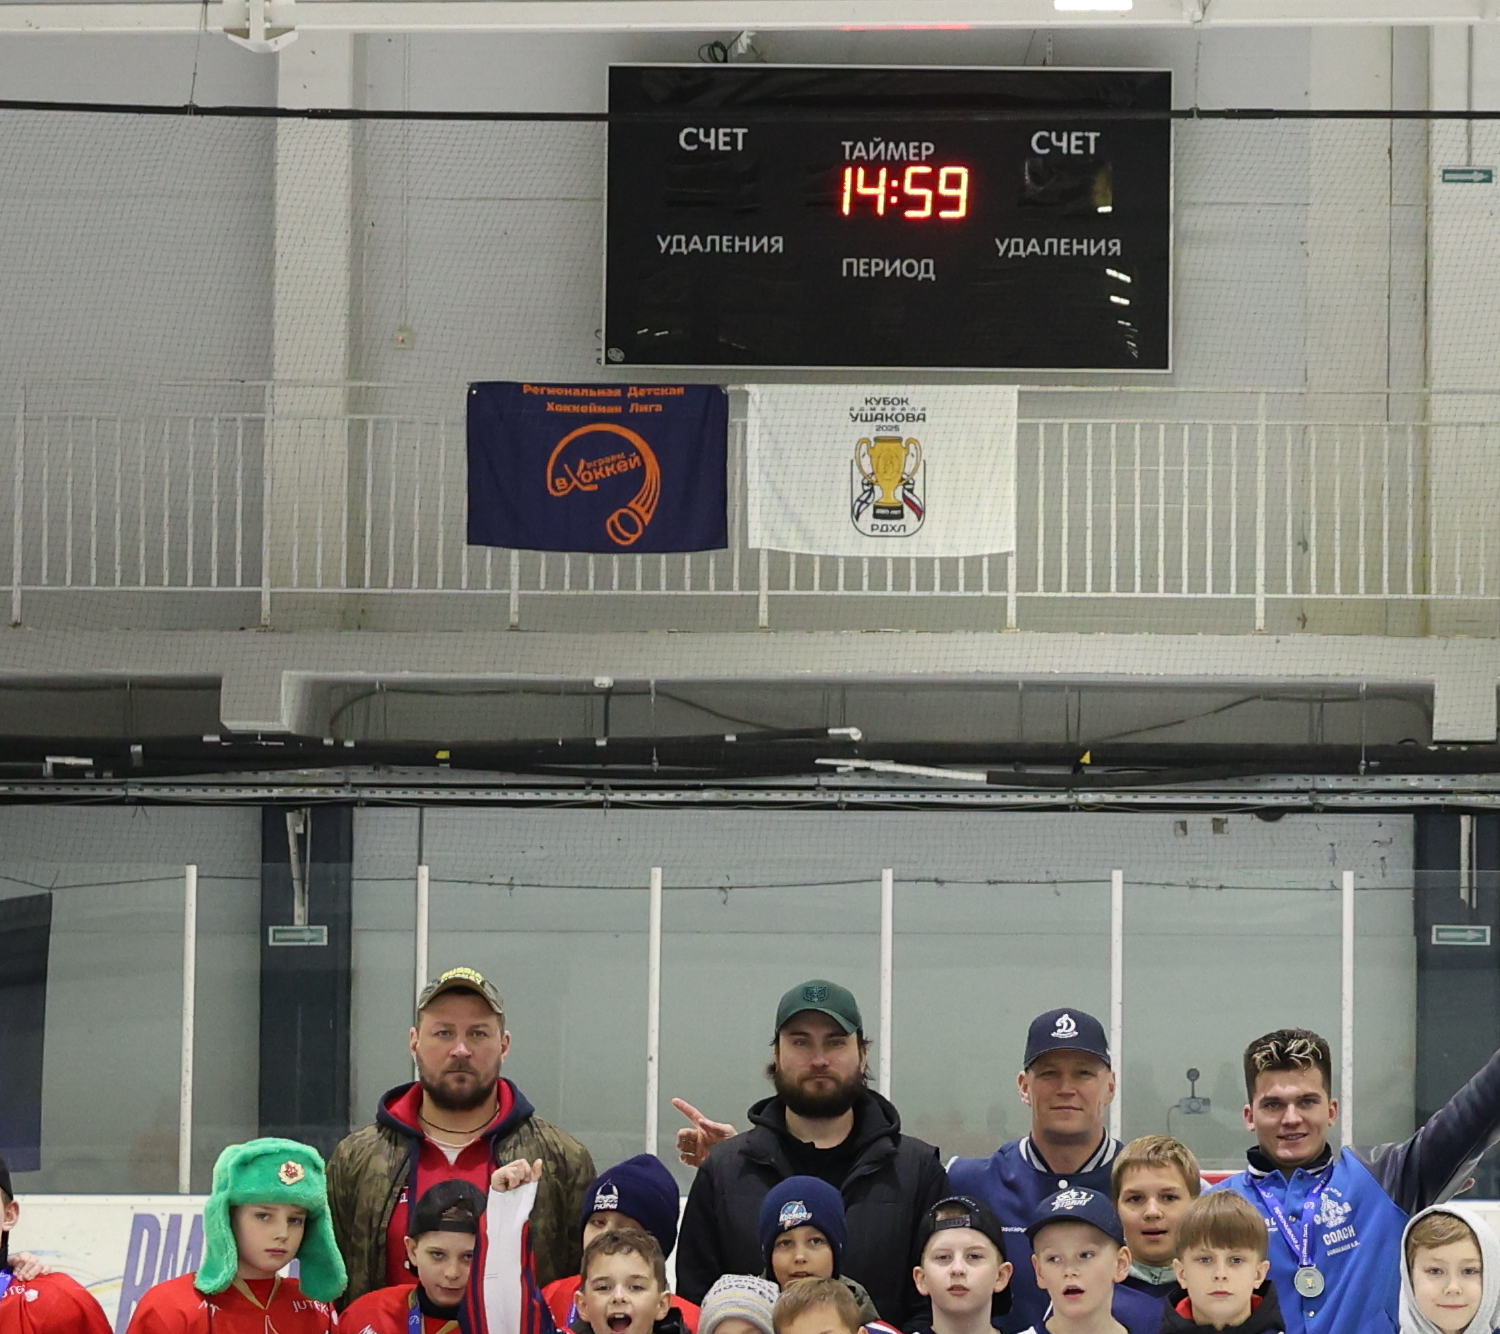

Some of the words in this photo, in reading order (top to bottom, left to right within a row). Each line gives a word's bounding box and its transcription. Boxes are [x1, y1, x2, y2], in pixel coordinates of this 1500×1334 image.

[678, 127, 748, 151] СЧЕТ
[842, 138, 935, 161] ТАЙМЕР
[1031, 131, 1101, 155] СЧЕТ
[842, 167, 969, 218] 14:59
[657, 234, 784, 255] УДАЛЕНИЯ
[995, 238, 1121, 258] УДАЛЕНИЯ
[842, 259, 936, 281] ПЕРИОД
[522, 384, 621, 397] Региональная
[627, 386, 685, 398] Детская
[865, 397, 909, 406] КУБОК
[629, 402, 663, 413] Лига
[850, 413, 926, 422] УШАКОВА
[871, 524, 906, 533] РДХЛ
[1323, 1225, 1356, 1246] COACH
